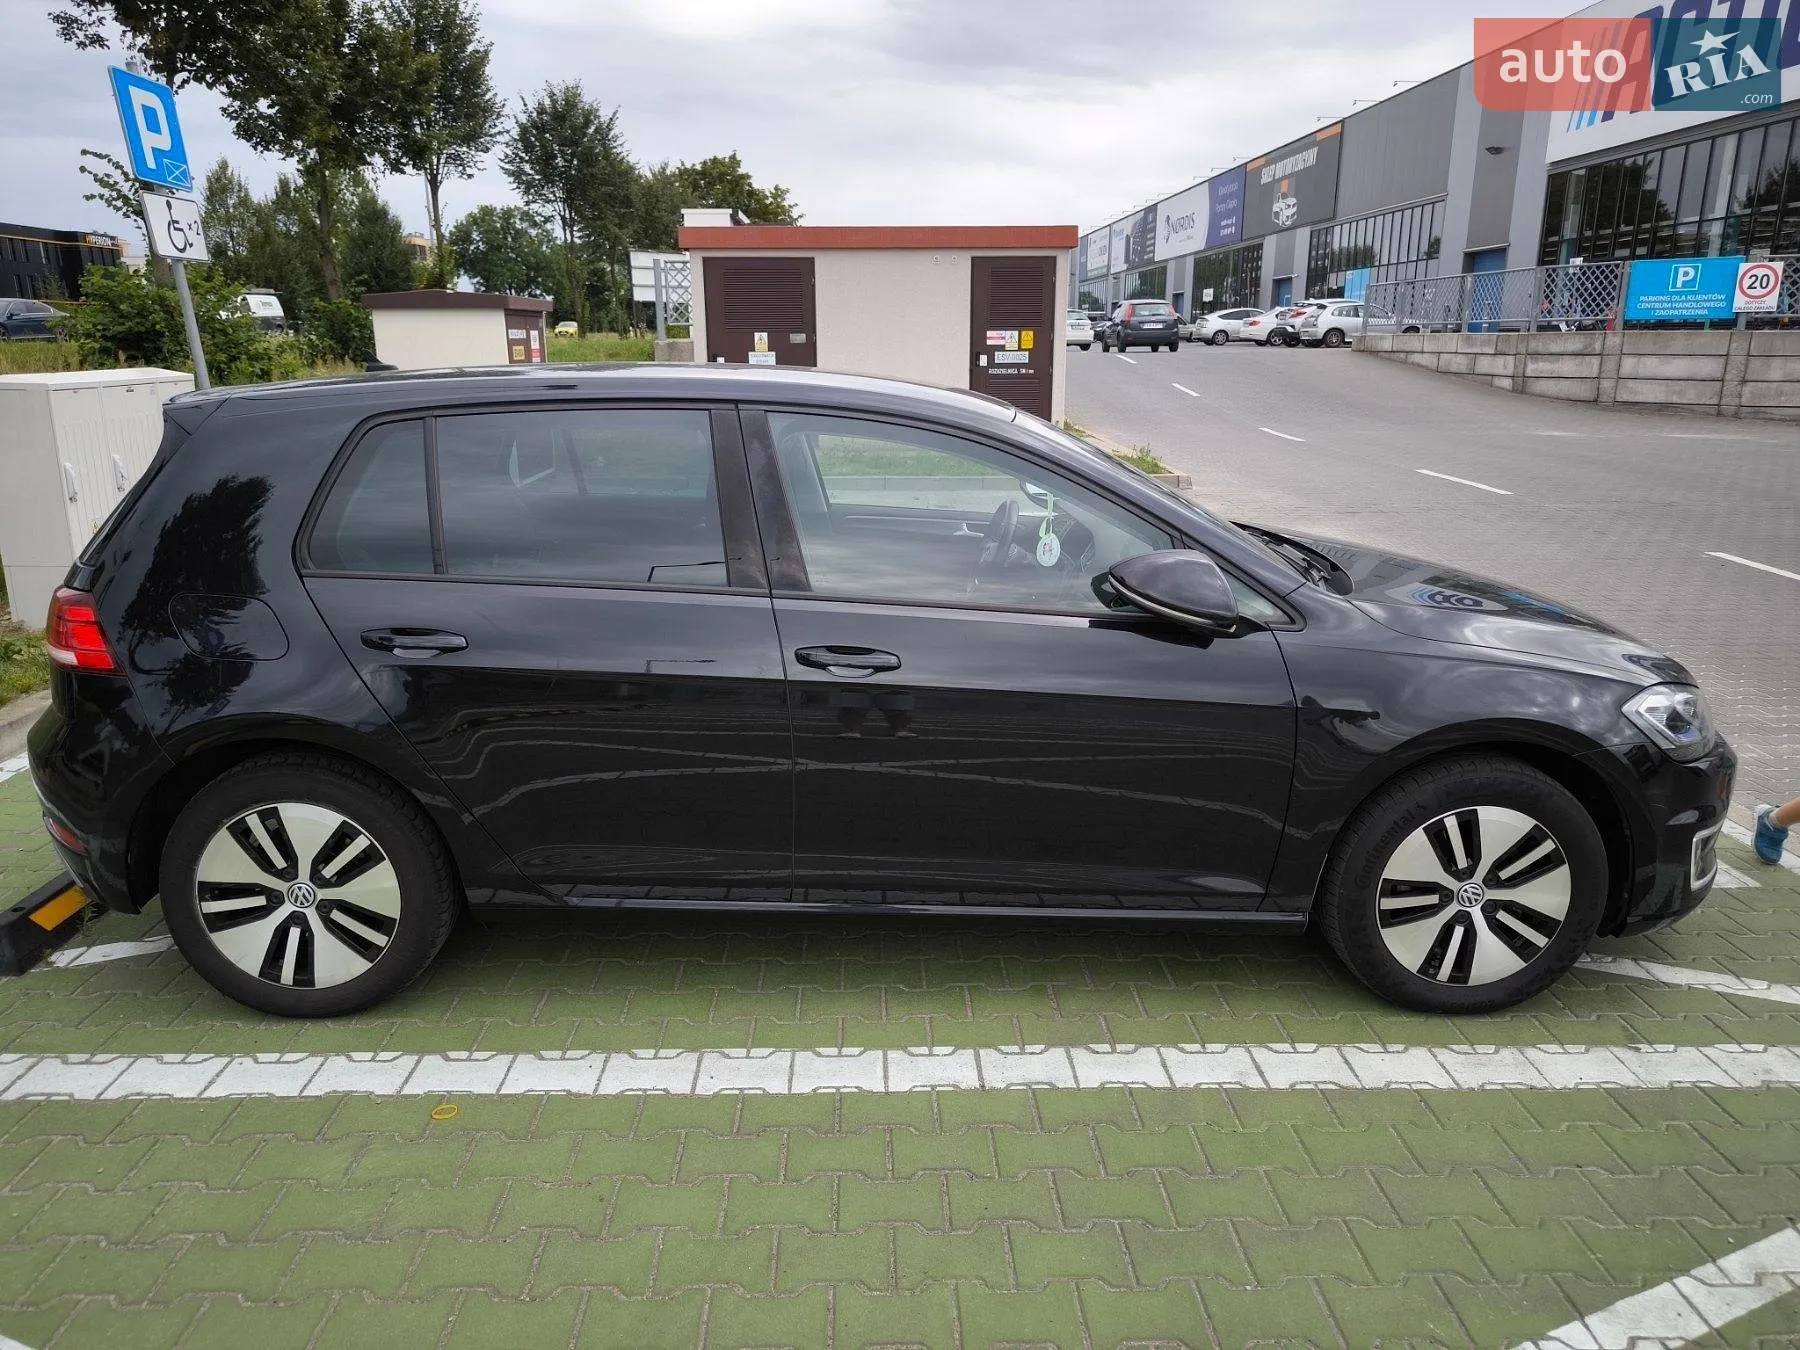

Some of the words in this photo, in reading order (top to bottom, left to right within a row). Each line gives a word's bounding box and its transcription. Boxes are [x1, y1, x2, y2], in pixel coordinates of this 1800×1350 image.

[128, 85, 172, 169] P
[1675, 267, 1695, 289] P
[1746, 273, 1771, 290] 20
[1672, 301, 1727, 309] HANDLOWEGO
[1686, 293, 1727, 301] KLIENTÓW
[1354, 808, 1416, 891] Continental
